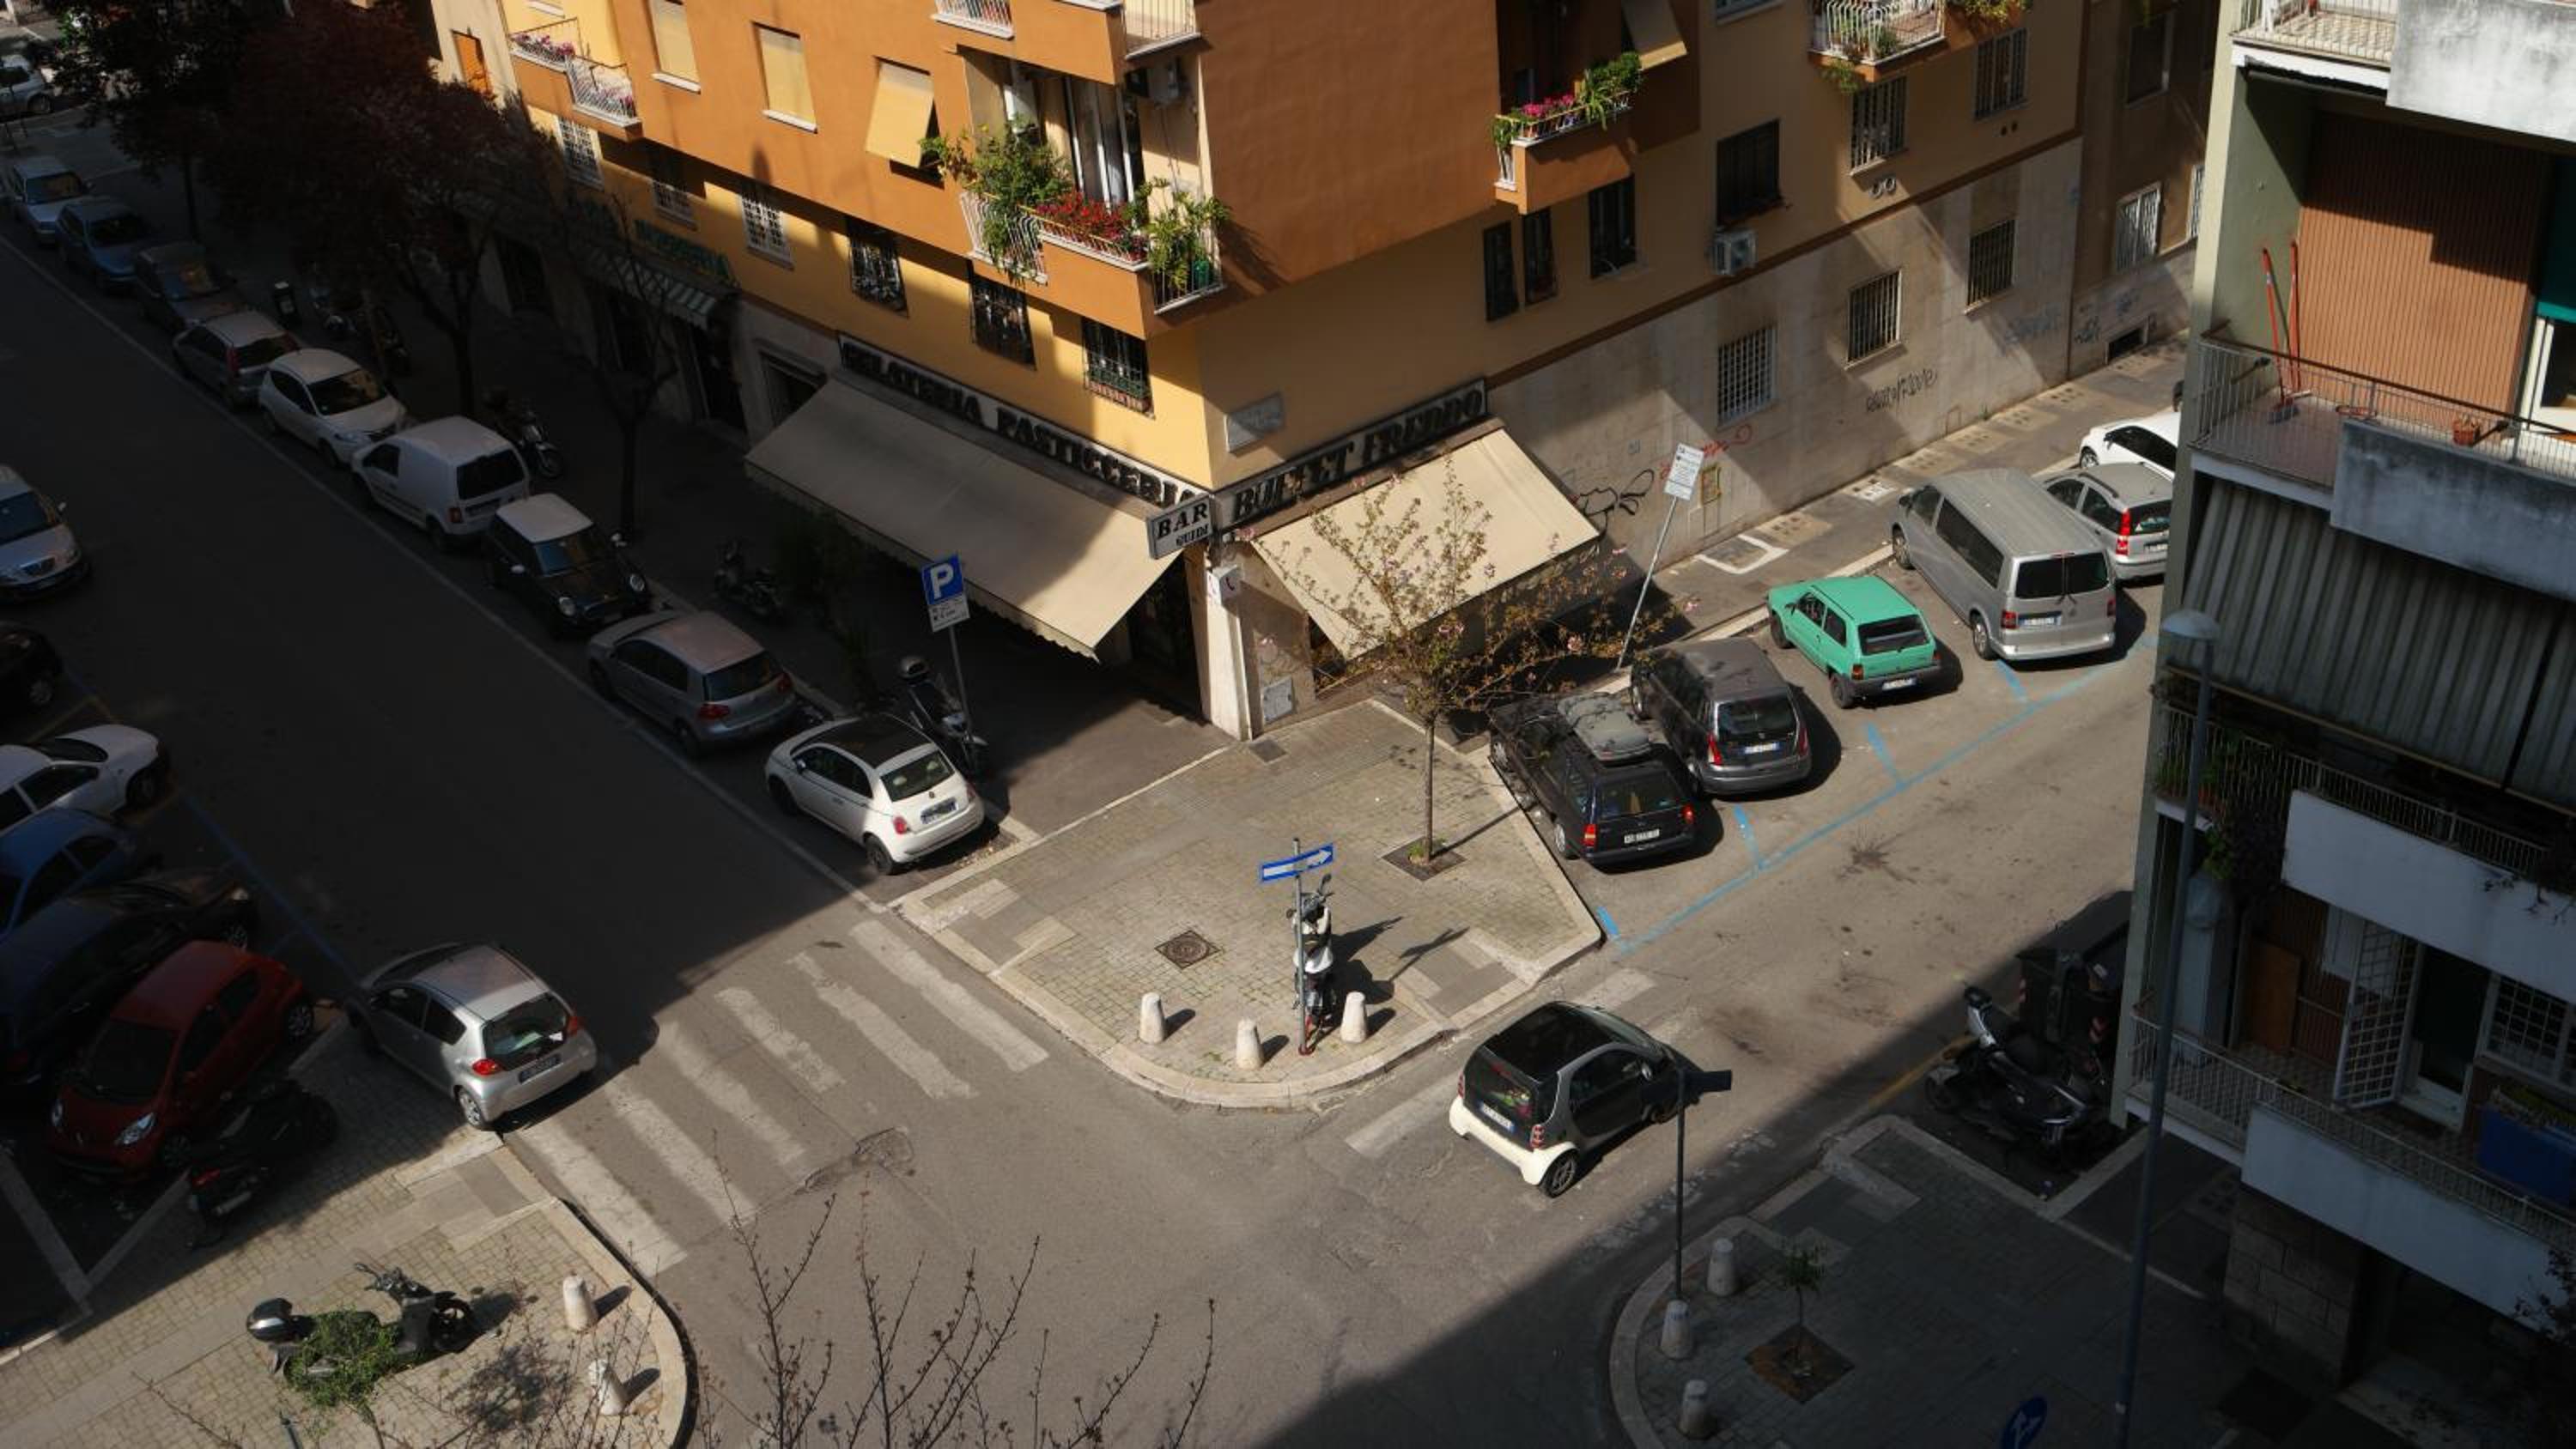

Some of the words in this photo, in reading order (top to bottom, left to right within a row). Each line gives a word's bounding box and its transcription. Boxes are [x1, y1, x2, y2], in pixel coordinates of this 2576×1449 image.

[1231, 441, 1354, 522] BUFET
[1361, 390, 1484, 464] FREDDO
[1157, 502, 1209, 540] BAR
[930, 563, 954, 599] P
